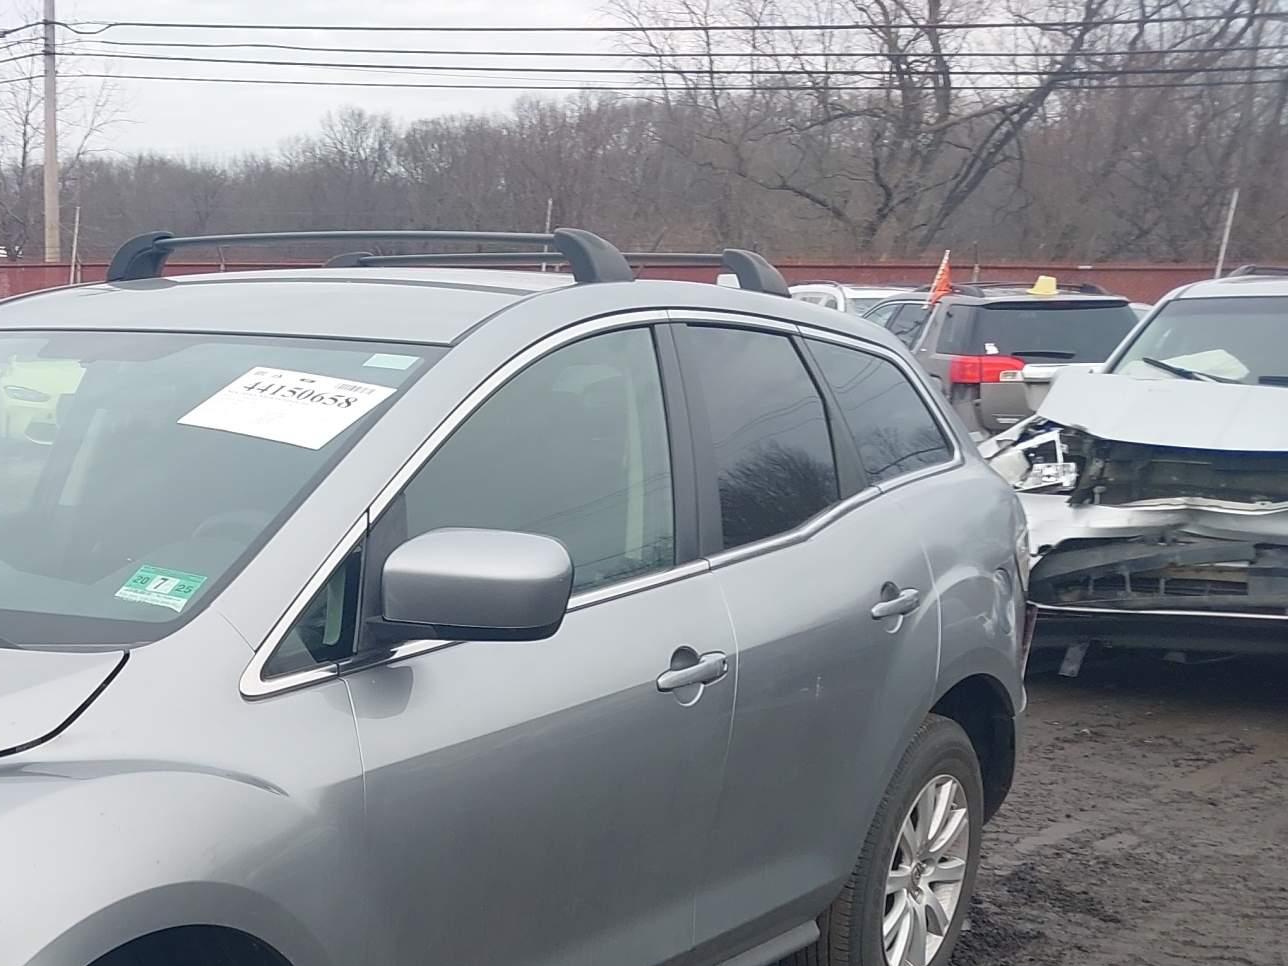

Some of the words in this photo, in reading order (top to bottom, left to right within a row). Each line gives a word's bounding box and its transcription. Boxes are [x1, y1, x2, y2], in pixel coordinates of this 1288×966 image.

[243, 381, 358, 408] 44150658
[132, 575, 150, 585] 20
[153, 577, 169, 590] 7
[175, 584, 194, 594] 25
